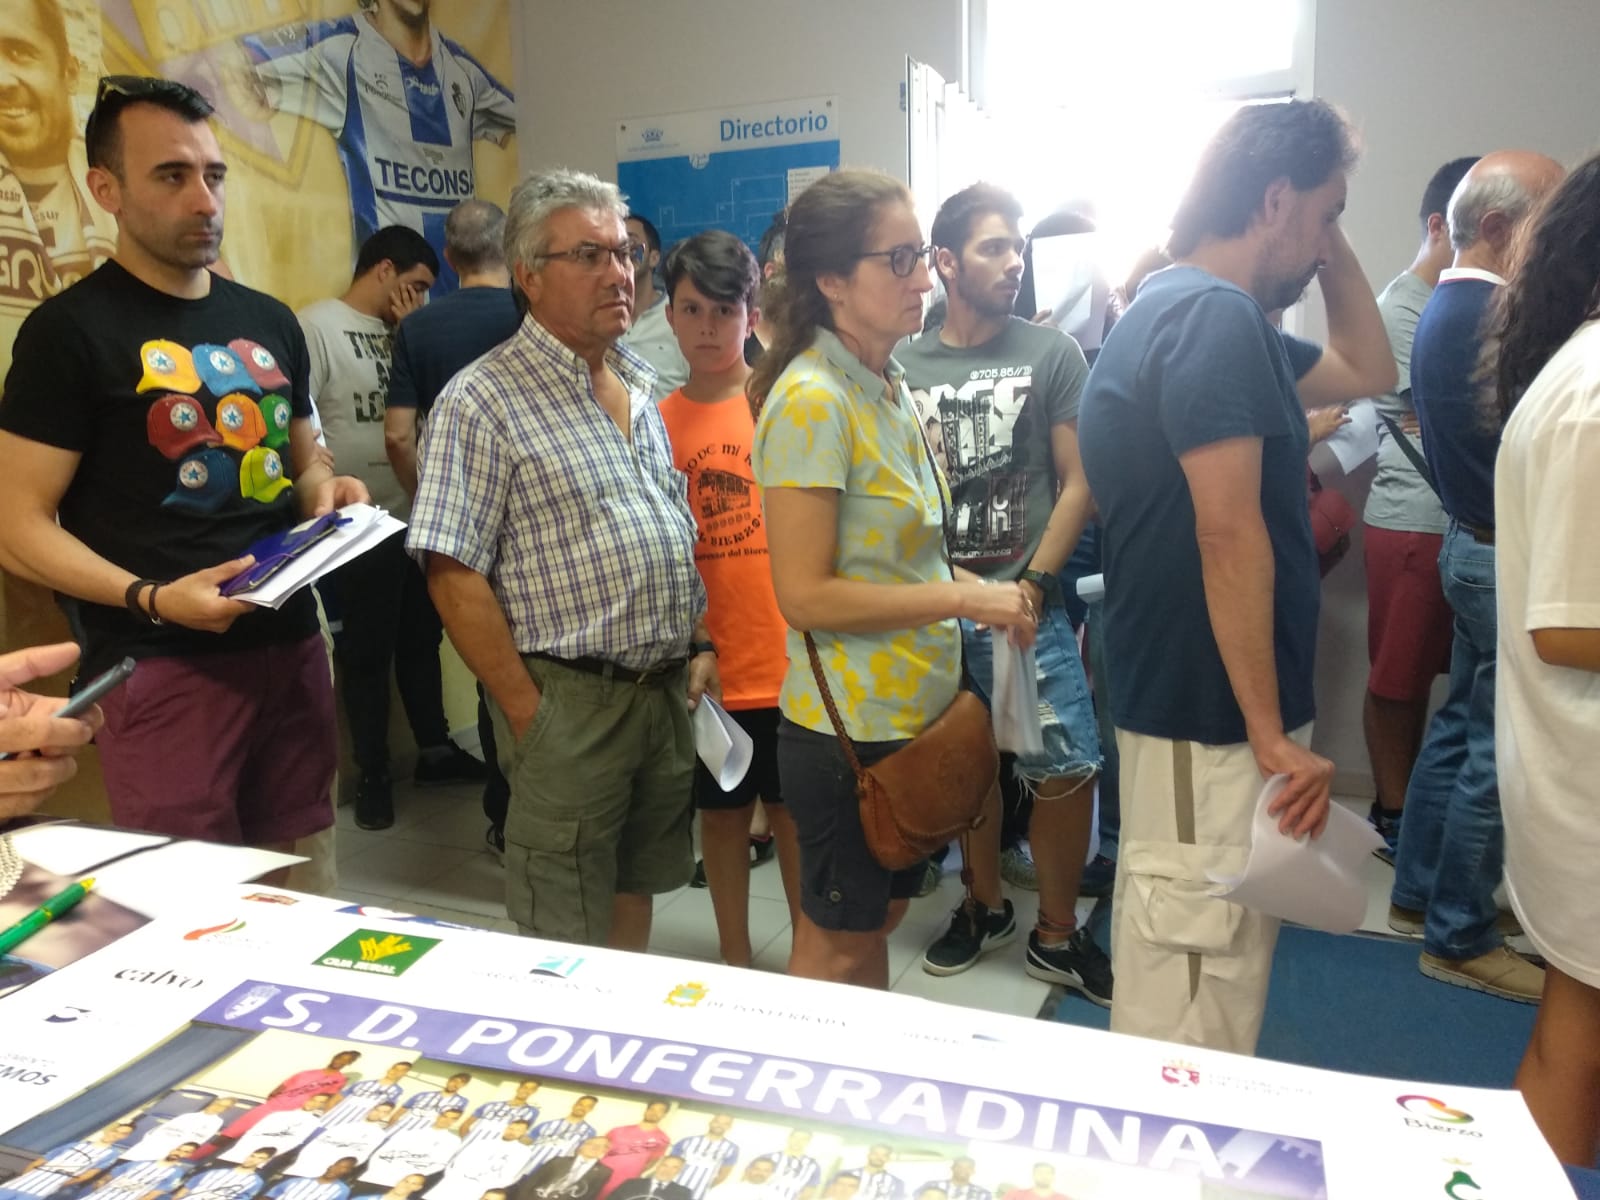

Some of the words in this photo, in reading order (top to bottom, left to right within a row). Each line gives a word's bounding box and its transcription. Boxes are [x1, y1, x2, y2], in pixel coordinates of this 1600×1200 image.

[719, 110, 828, 142] Directorio
[260, 992, 331, 1033] S.
[347, 1004, 420, 1048] D.
[446, 1018, 1226, 1180] PONFERRADINA
[1402, 1116, 1484, 1139] Bierzo
